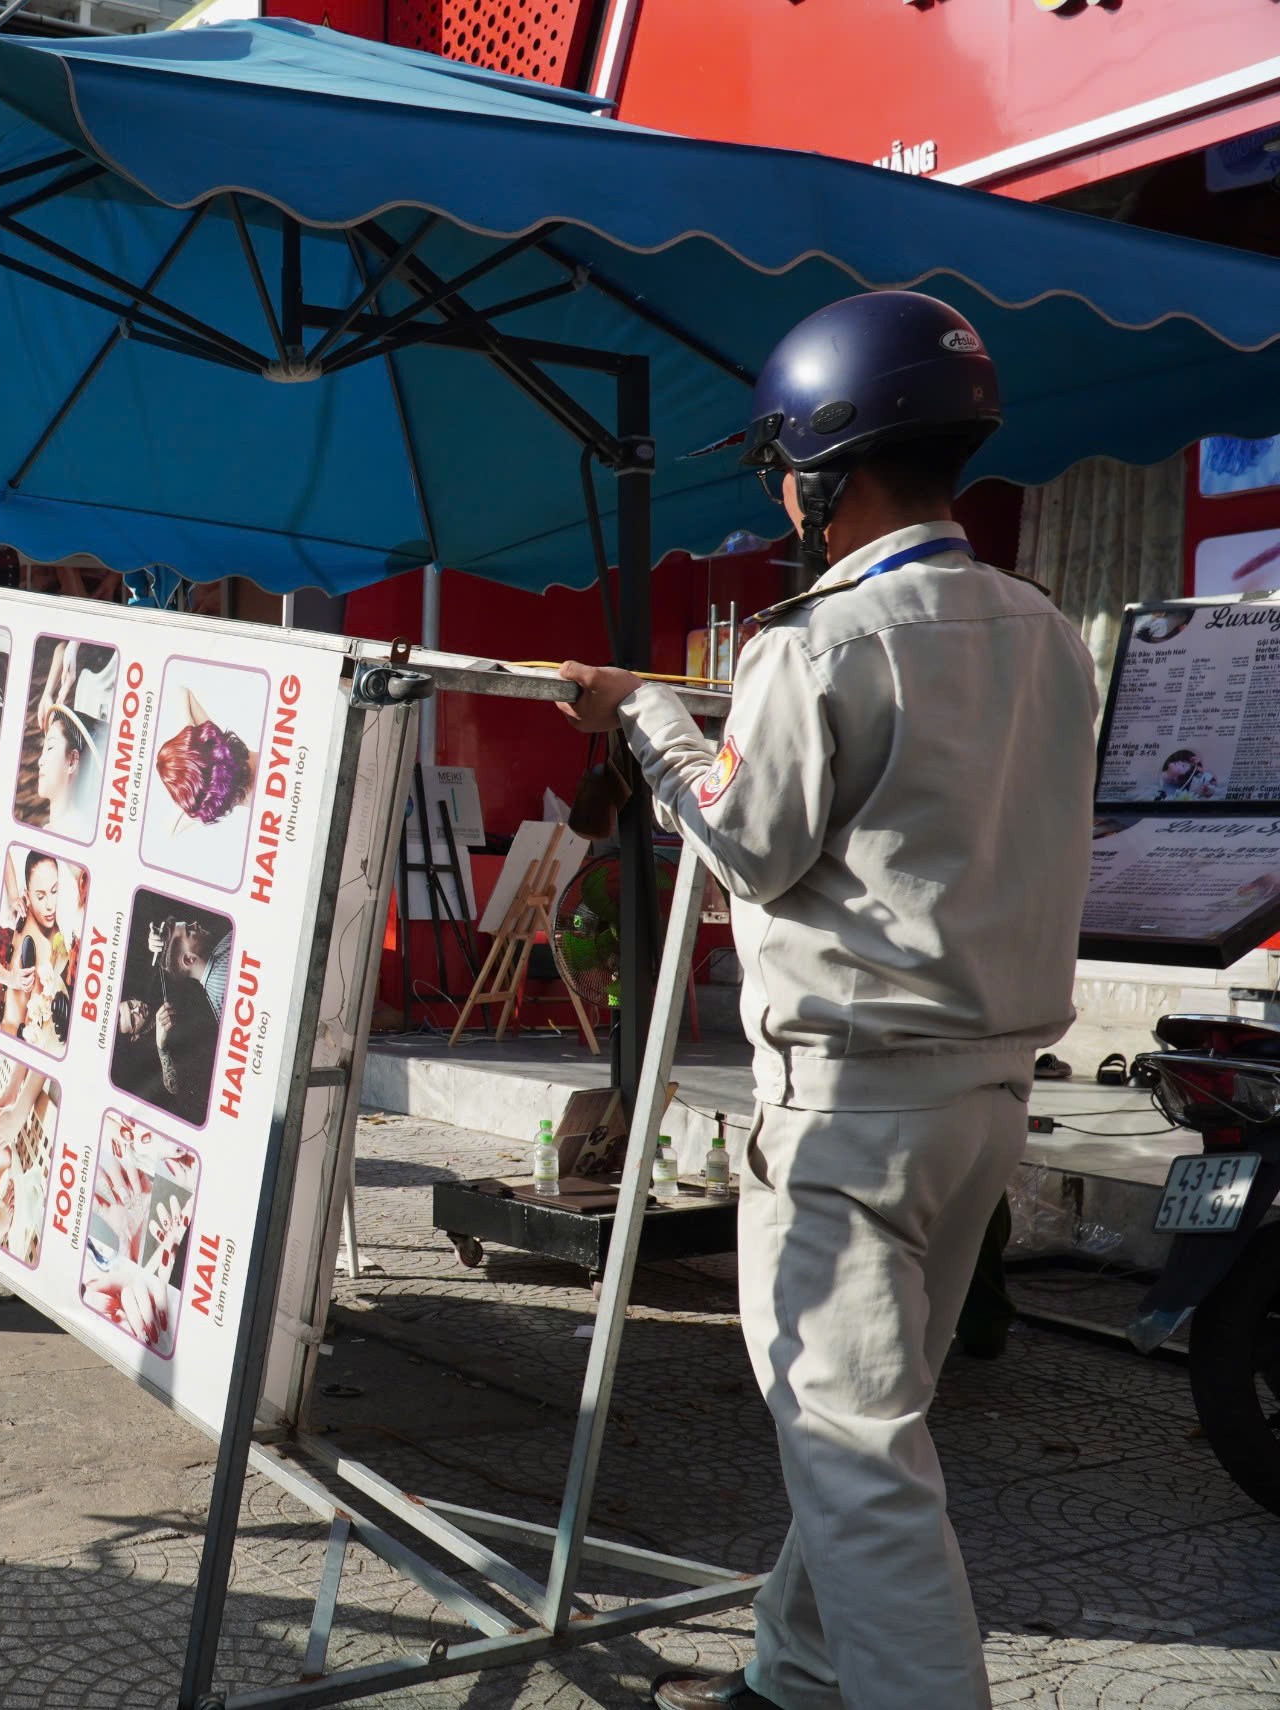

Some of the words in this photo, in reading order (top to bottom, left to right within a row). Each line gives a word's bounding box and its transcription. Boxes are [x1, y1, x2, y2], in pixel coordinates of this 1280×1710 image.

[105, 661, 144, 843] SHAMPOO
[139, 690, 155, 759] massage)
[265, 674, 301, 801] DYING
[285, 781, 302, 842] (Nhuộm
[295, 745, 309, 775] tóc)
[1155, 820, 1255, 838] Luxury
[250, 810, 282, 904] HAIR
[108, 951, 117, 980] toàn
[112, 911, 124, 947] thân)
[81, 926, 108, 1023] BODY
[98, 985, 113, 1050] (Massage
[220, 950, 262, 1119] HAIRCUT
[258, 1011, 271, 1040] tóc)
[53, 1142, 78, 1235] FOOT
[71, 1186, 86, 1250] (Massage
[81, 1145, 93, 1183] chân)
[1160, 1194, 1240, 1226] 514.97
[1178, 1159, 1241, 1192] 43-E1
[191, 1234, 220, 1316] NAIL
[213, 1292, 226, 1327] (Làm
[221, 1238, 236, 1286] móng)
